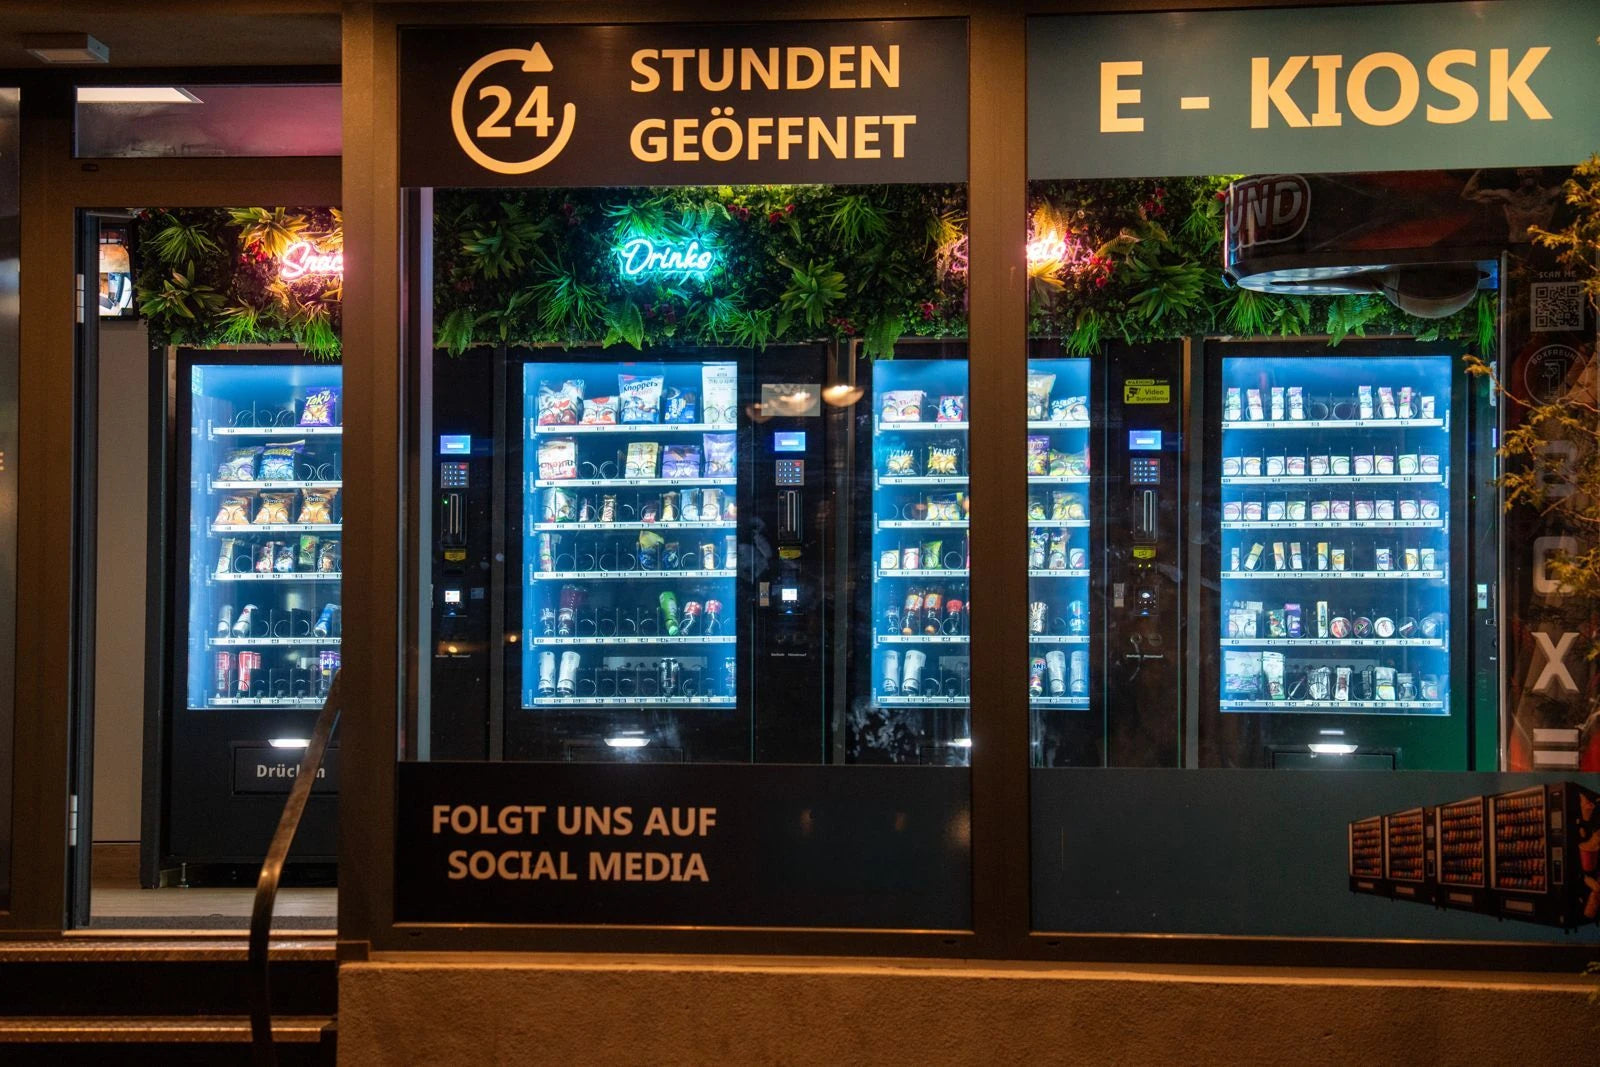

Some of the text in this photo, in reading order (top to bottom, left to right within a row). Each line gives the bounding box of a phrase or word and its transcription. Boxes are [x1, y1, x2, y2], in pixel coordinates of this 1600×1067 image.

[630, 44, 900, 93] STUNDEN
[1100, 61, 1144, 133] E
[1250, 46, 1553, 129] KIOSK
[476, 85, 554, 138] 24
[629, 106, 917, 163] GEÖFFNET
[281, 241, 343, 279] Snac
[621, 238, 713, 276] Drinks
[1539, 270, 1577, 279] SCAN ME
[623, 380, 659, 392] Knoppers
[256, 764, 326, 778] Drücn
[432, 805, 717, 837] FOLGT UNS AUF
[448, 850, 710, 882] SOCIAL MEDIA
